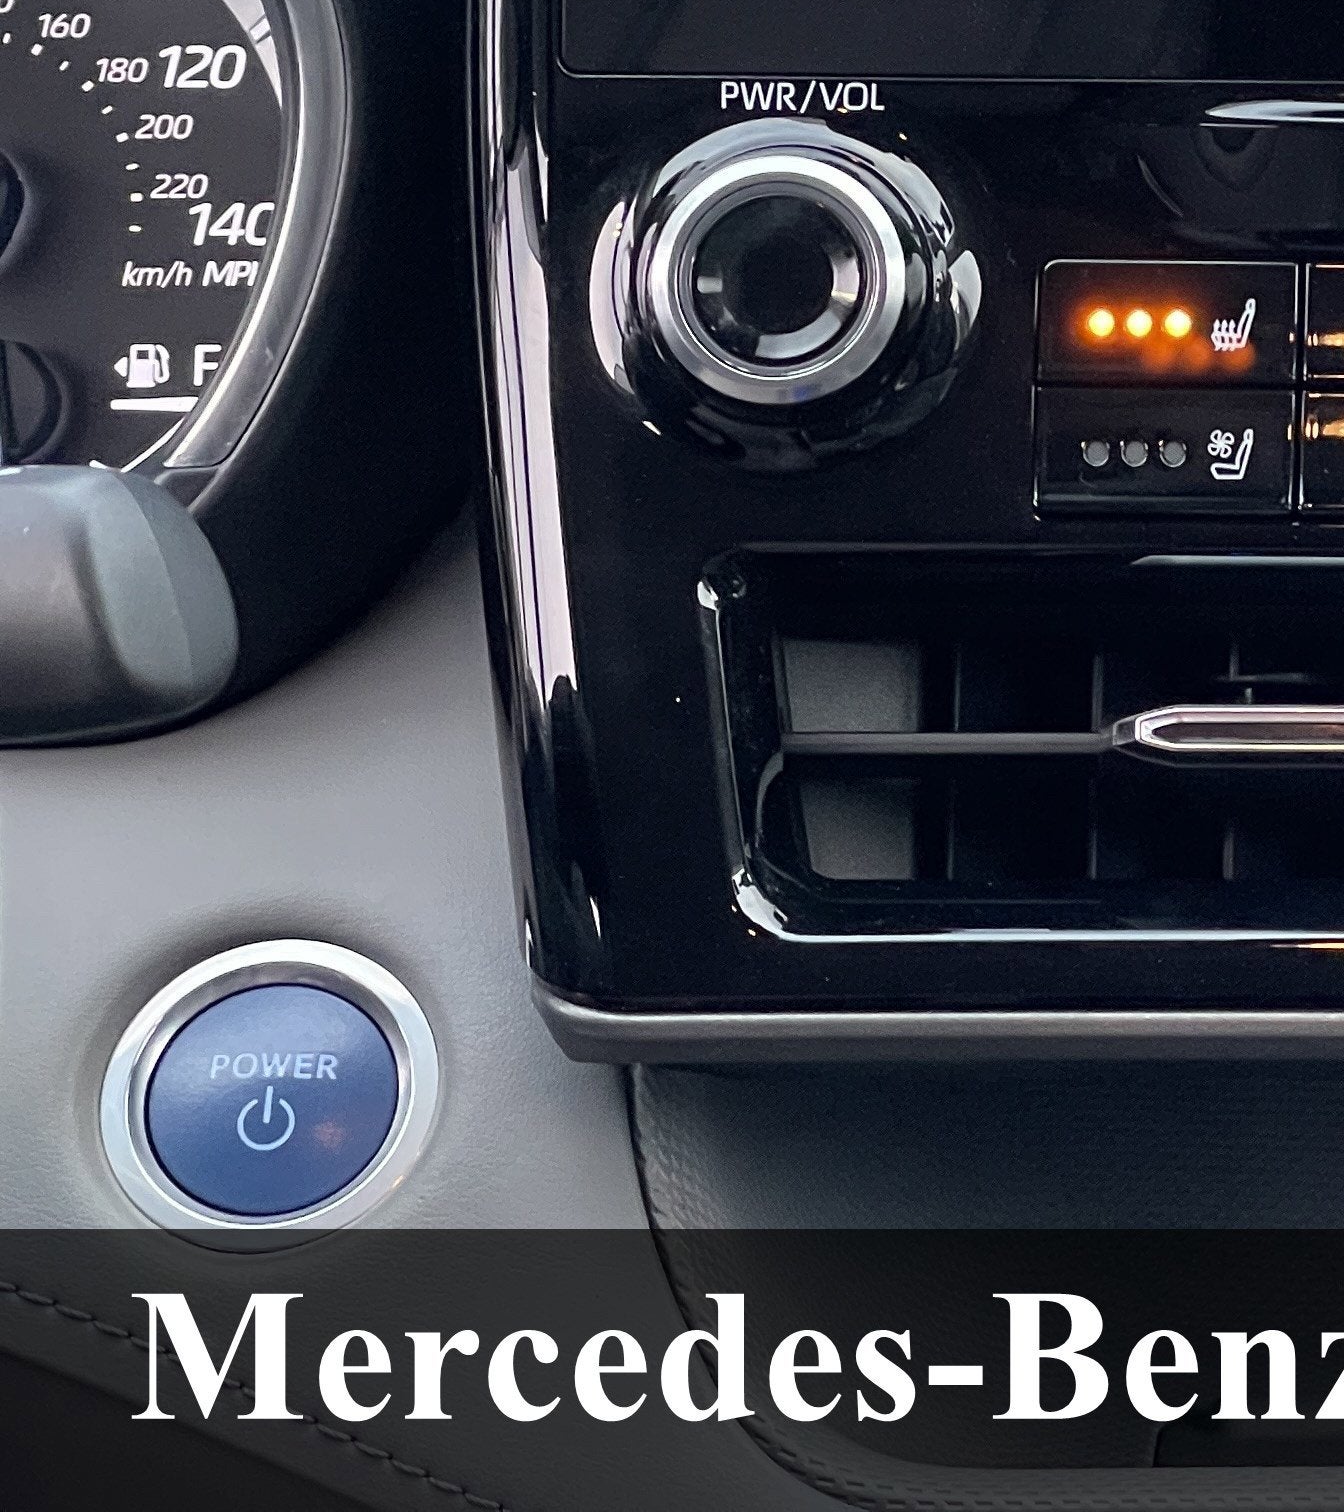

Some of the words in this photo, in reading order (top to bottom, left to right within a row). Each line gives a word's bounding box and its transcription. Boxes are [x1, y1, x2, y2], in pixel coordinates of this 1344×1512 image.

[38, 13, 91, 39] 160
[96, 57, 150, 83] 180
[158, 44, 247, 90] 120
[720, 79, 885, 113] PWR/VOL
[134, 113, 194, 140] 200
[149, 173, 209, 199] 220
[121, 260, 193, 289] km/h
[210, 1052, 339, 1081] POWER
